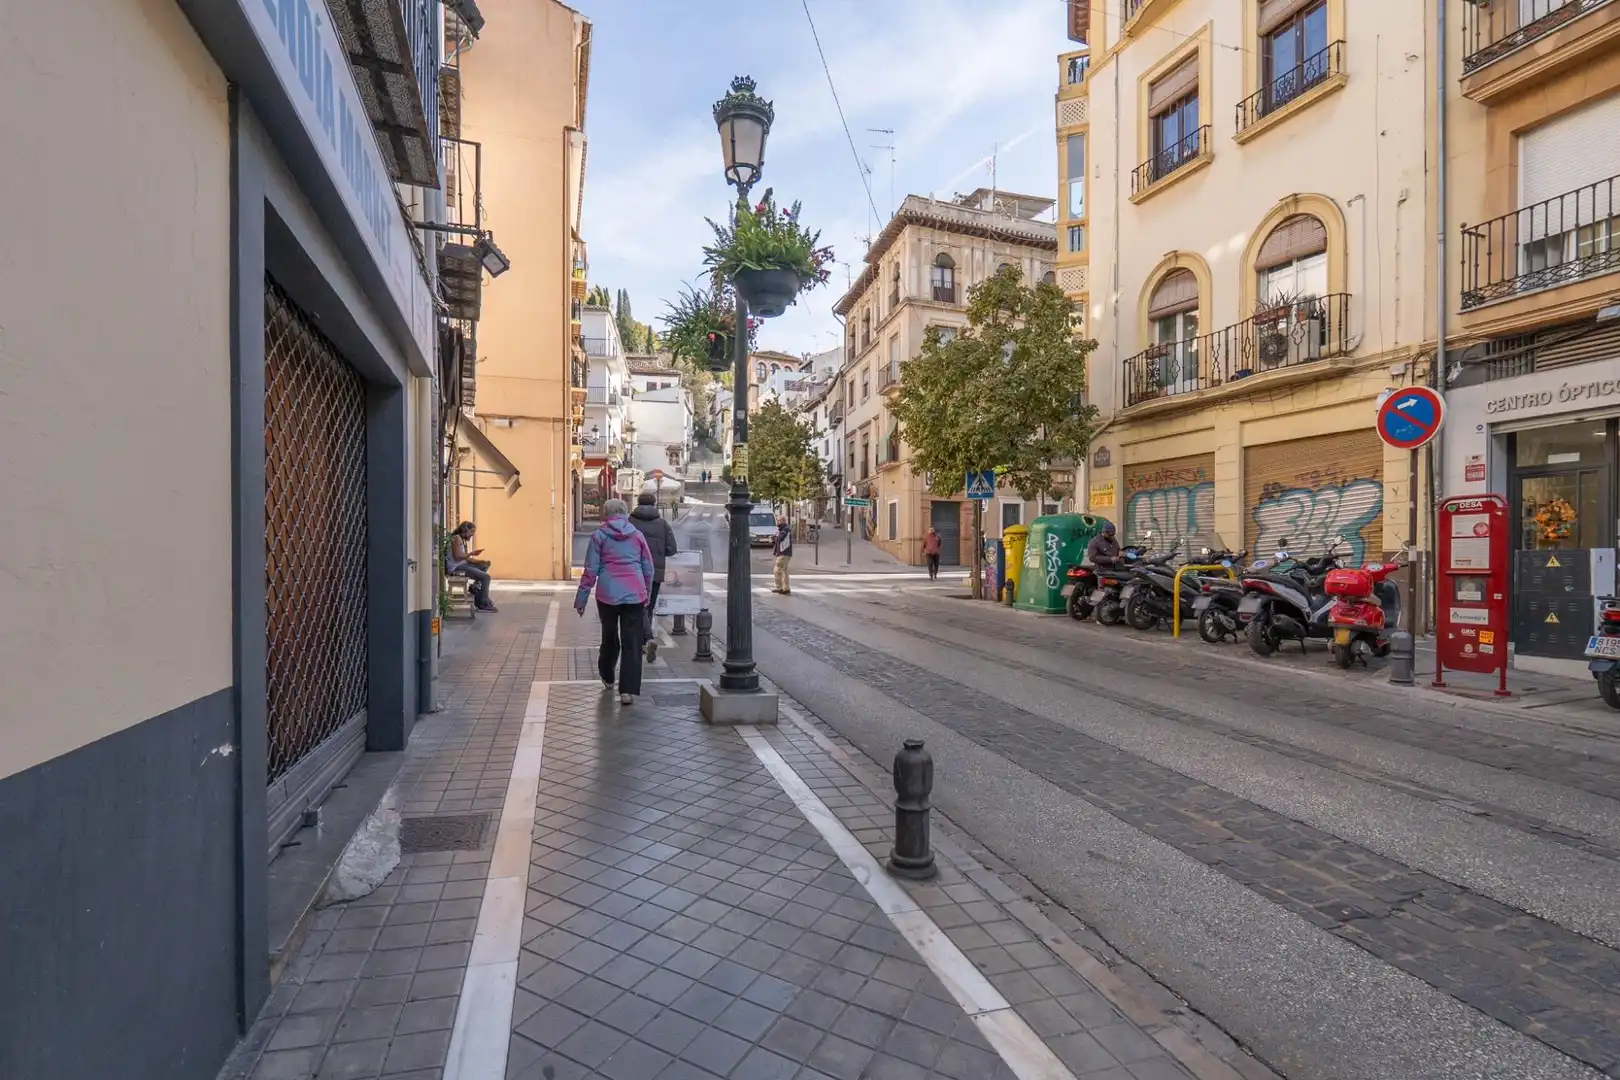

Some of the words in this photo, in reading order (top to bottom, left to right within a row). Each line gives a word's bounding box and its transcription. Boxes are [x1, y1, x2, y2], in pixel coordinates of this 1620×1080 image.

[339, 87, 392, 270] MARKET
[1486, 391, 1553, 414] CENTRO
[1460, 501, 1483, 509] DESA
[1595, 646, 1616, 655] NCS
